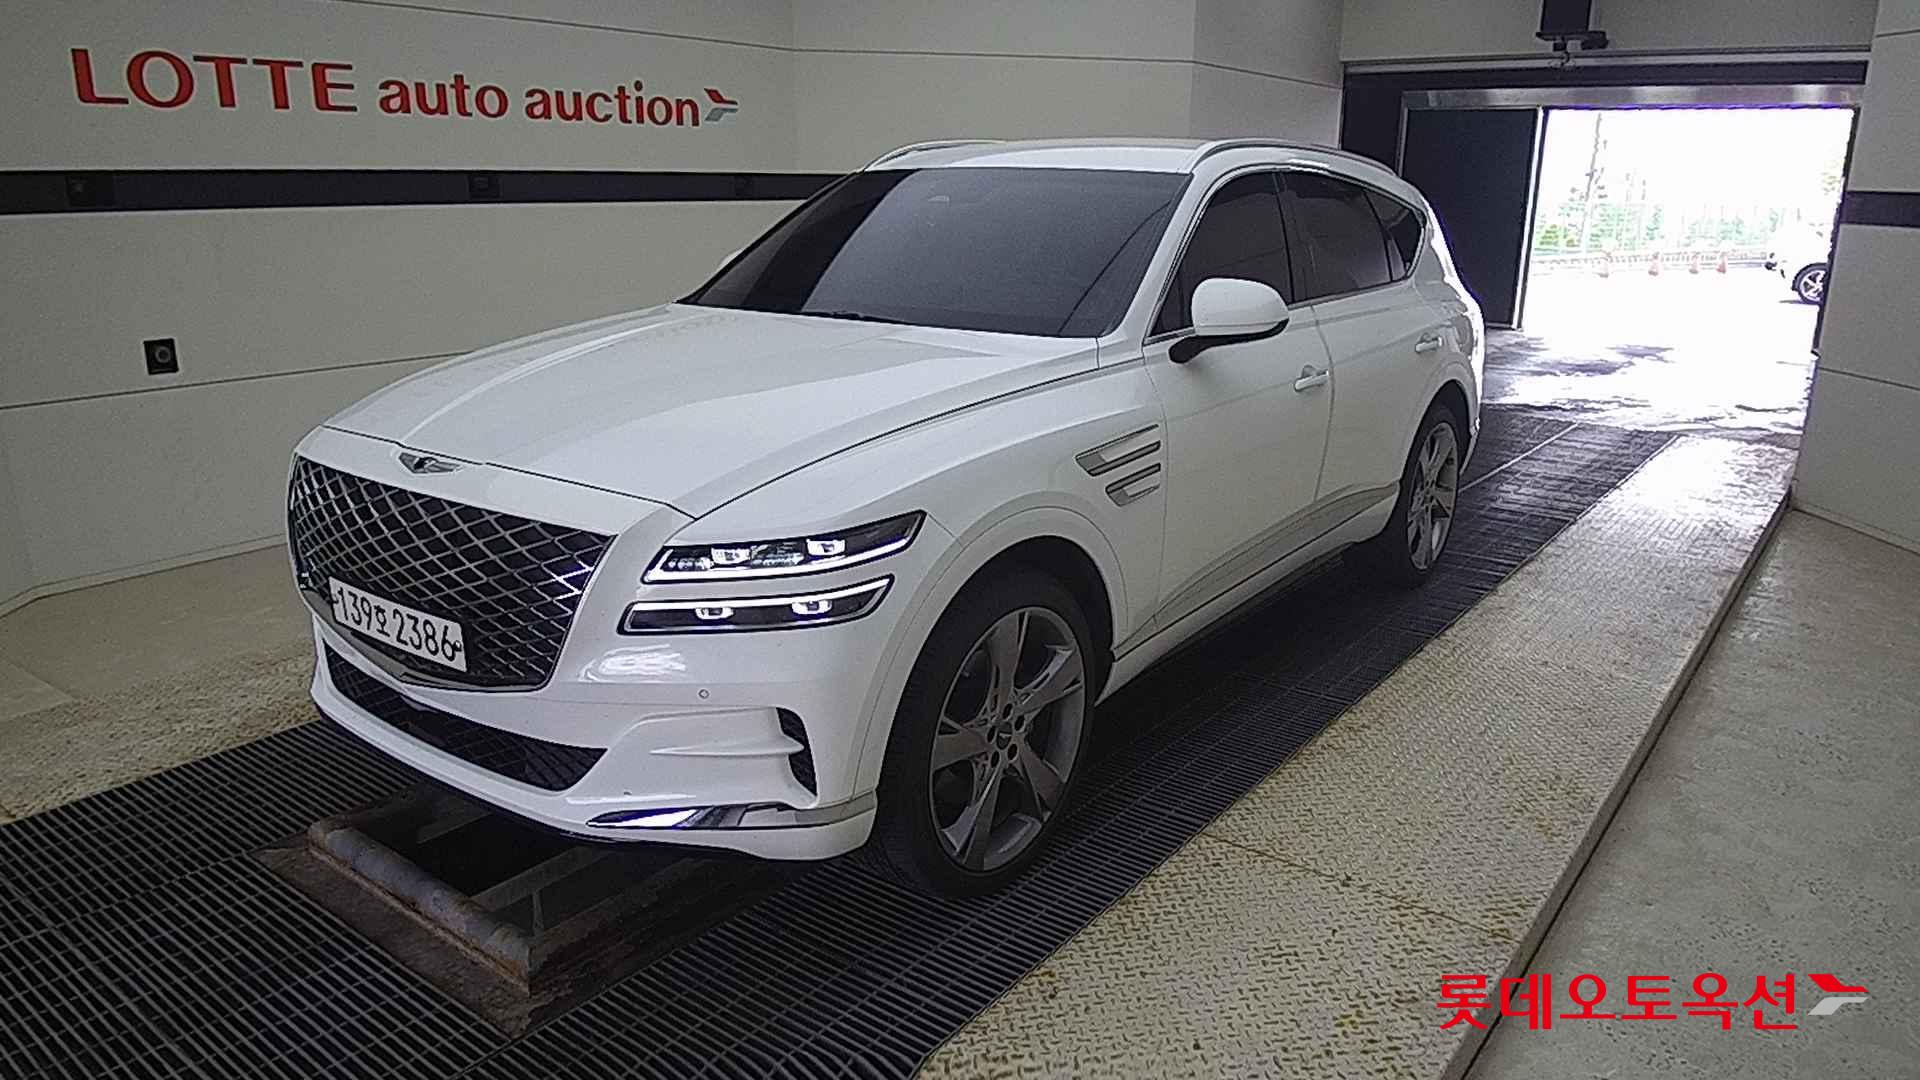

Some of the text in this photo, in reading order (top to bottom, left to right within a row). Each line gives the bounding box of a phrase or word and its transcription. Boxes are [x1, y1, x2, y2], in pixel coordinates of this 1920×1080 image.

[70, 47, 701, 127] LOTTE auto auction
[392, 608, 458, 662] 2386
